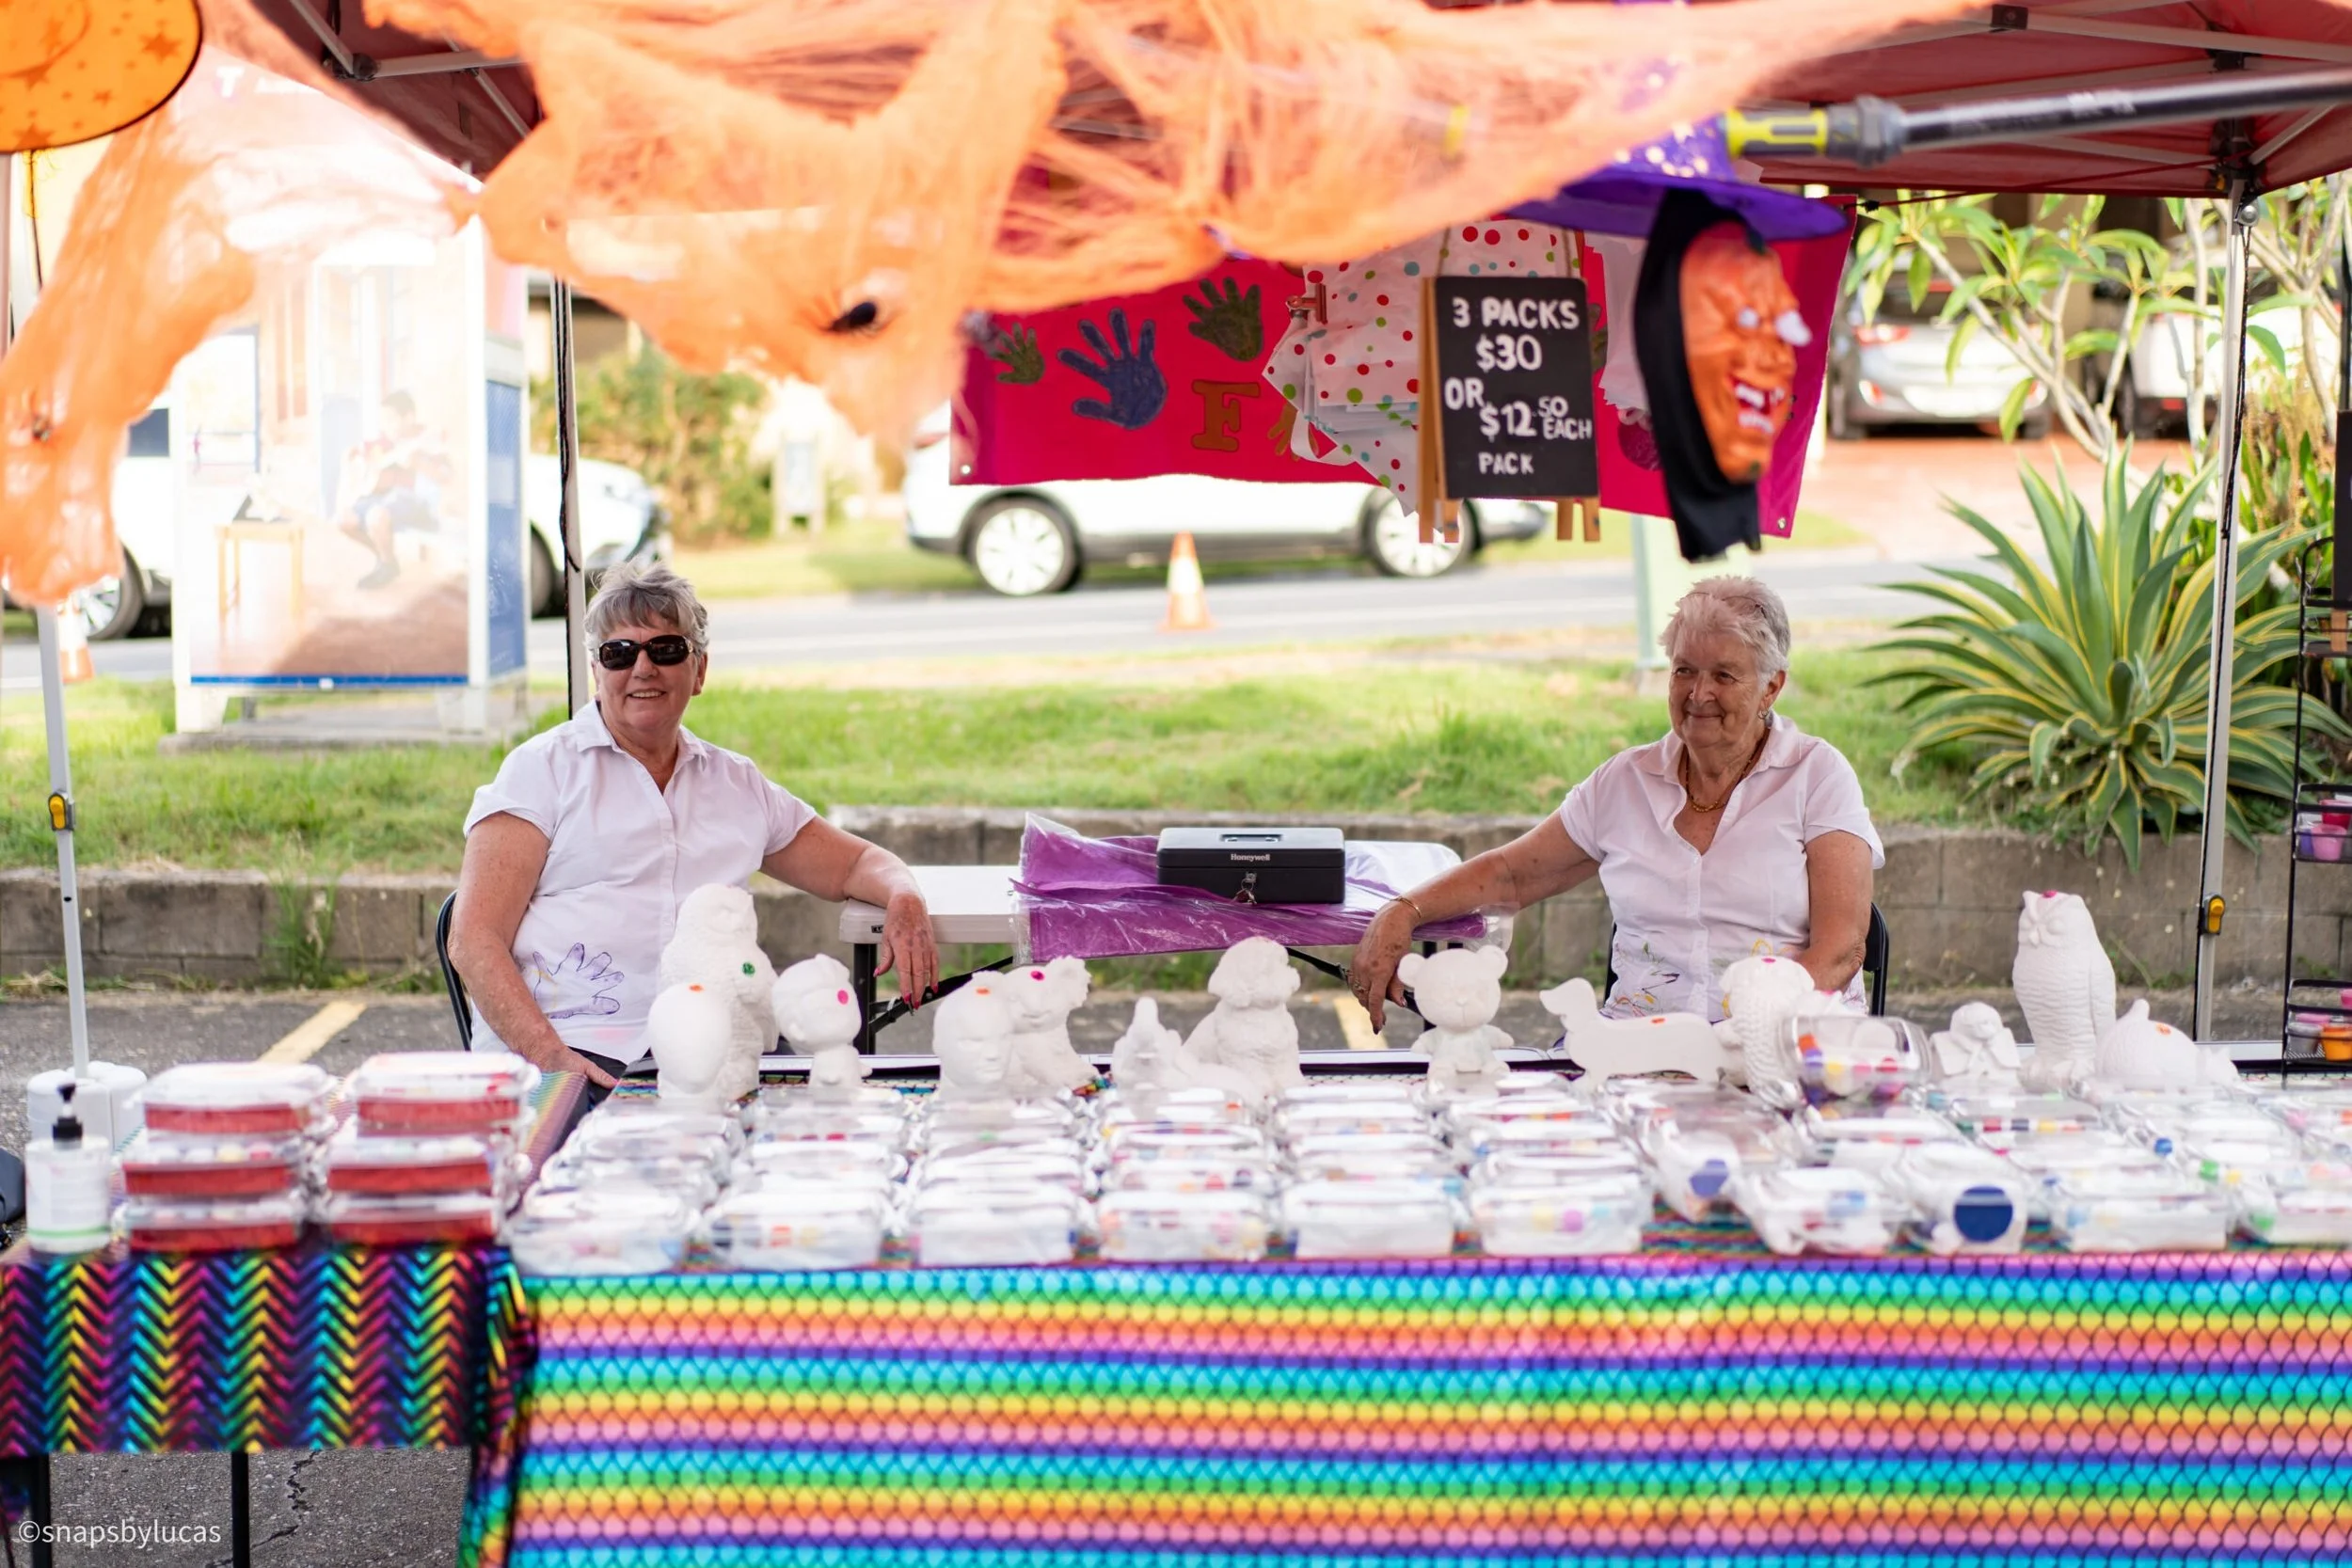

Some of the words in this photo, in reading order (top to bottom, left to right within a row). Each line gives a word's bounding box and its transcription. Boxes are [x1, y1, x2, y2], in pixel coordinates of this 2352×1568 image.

[1452, 295, 1471, 328] 3
[1480, 295, 1581, 330] PACKS
[1475, 333, 1543, 373] $30
[1444, 376, 1486, 410] OR
[1191, 378, 1261, 452] F
[1542, 417, 1593, 441] EACH
[1477, 451, 1534, 475] PACK
[1230, 853, 1271, 863] Honeywell
